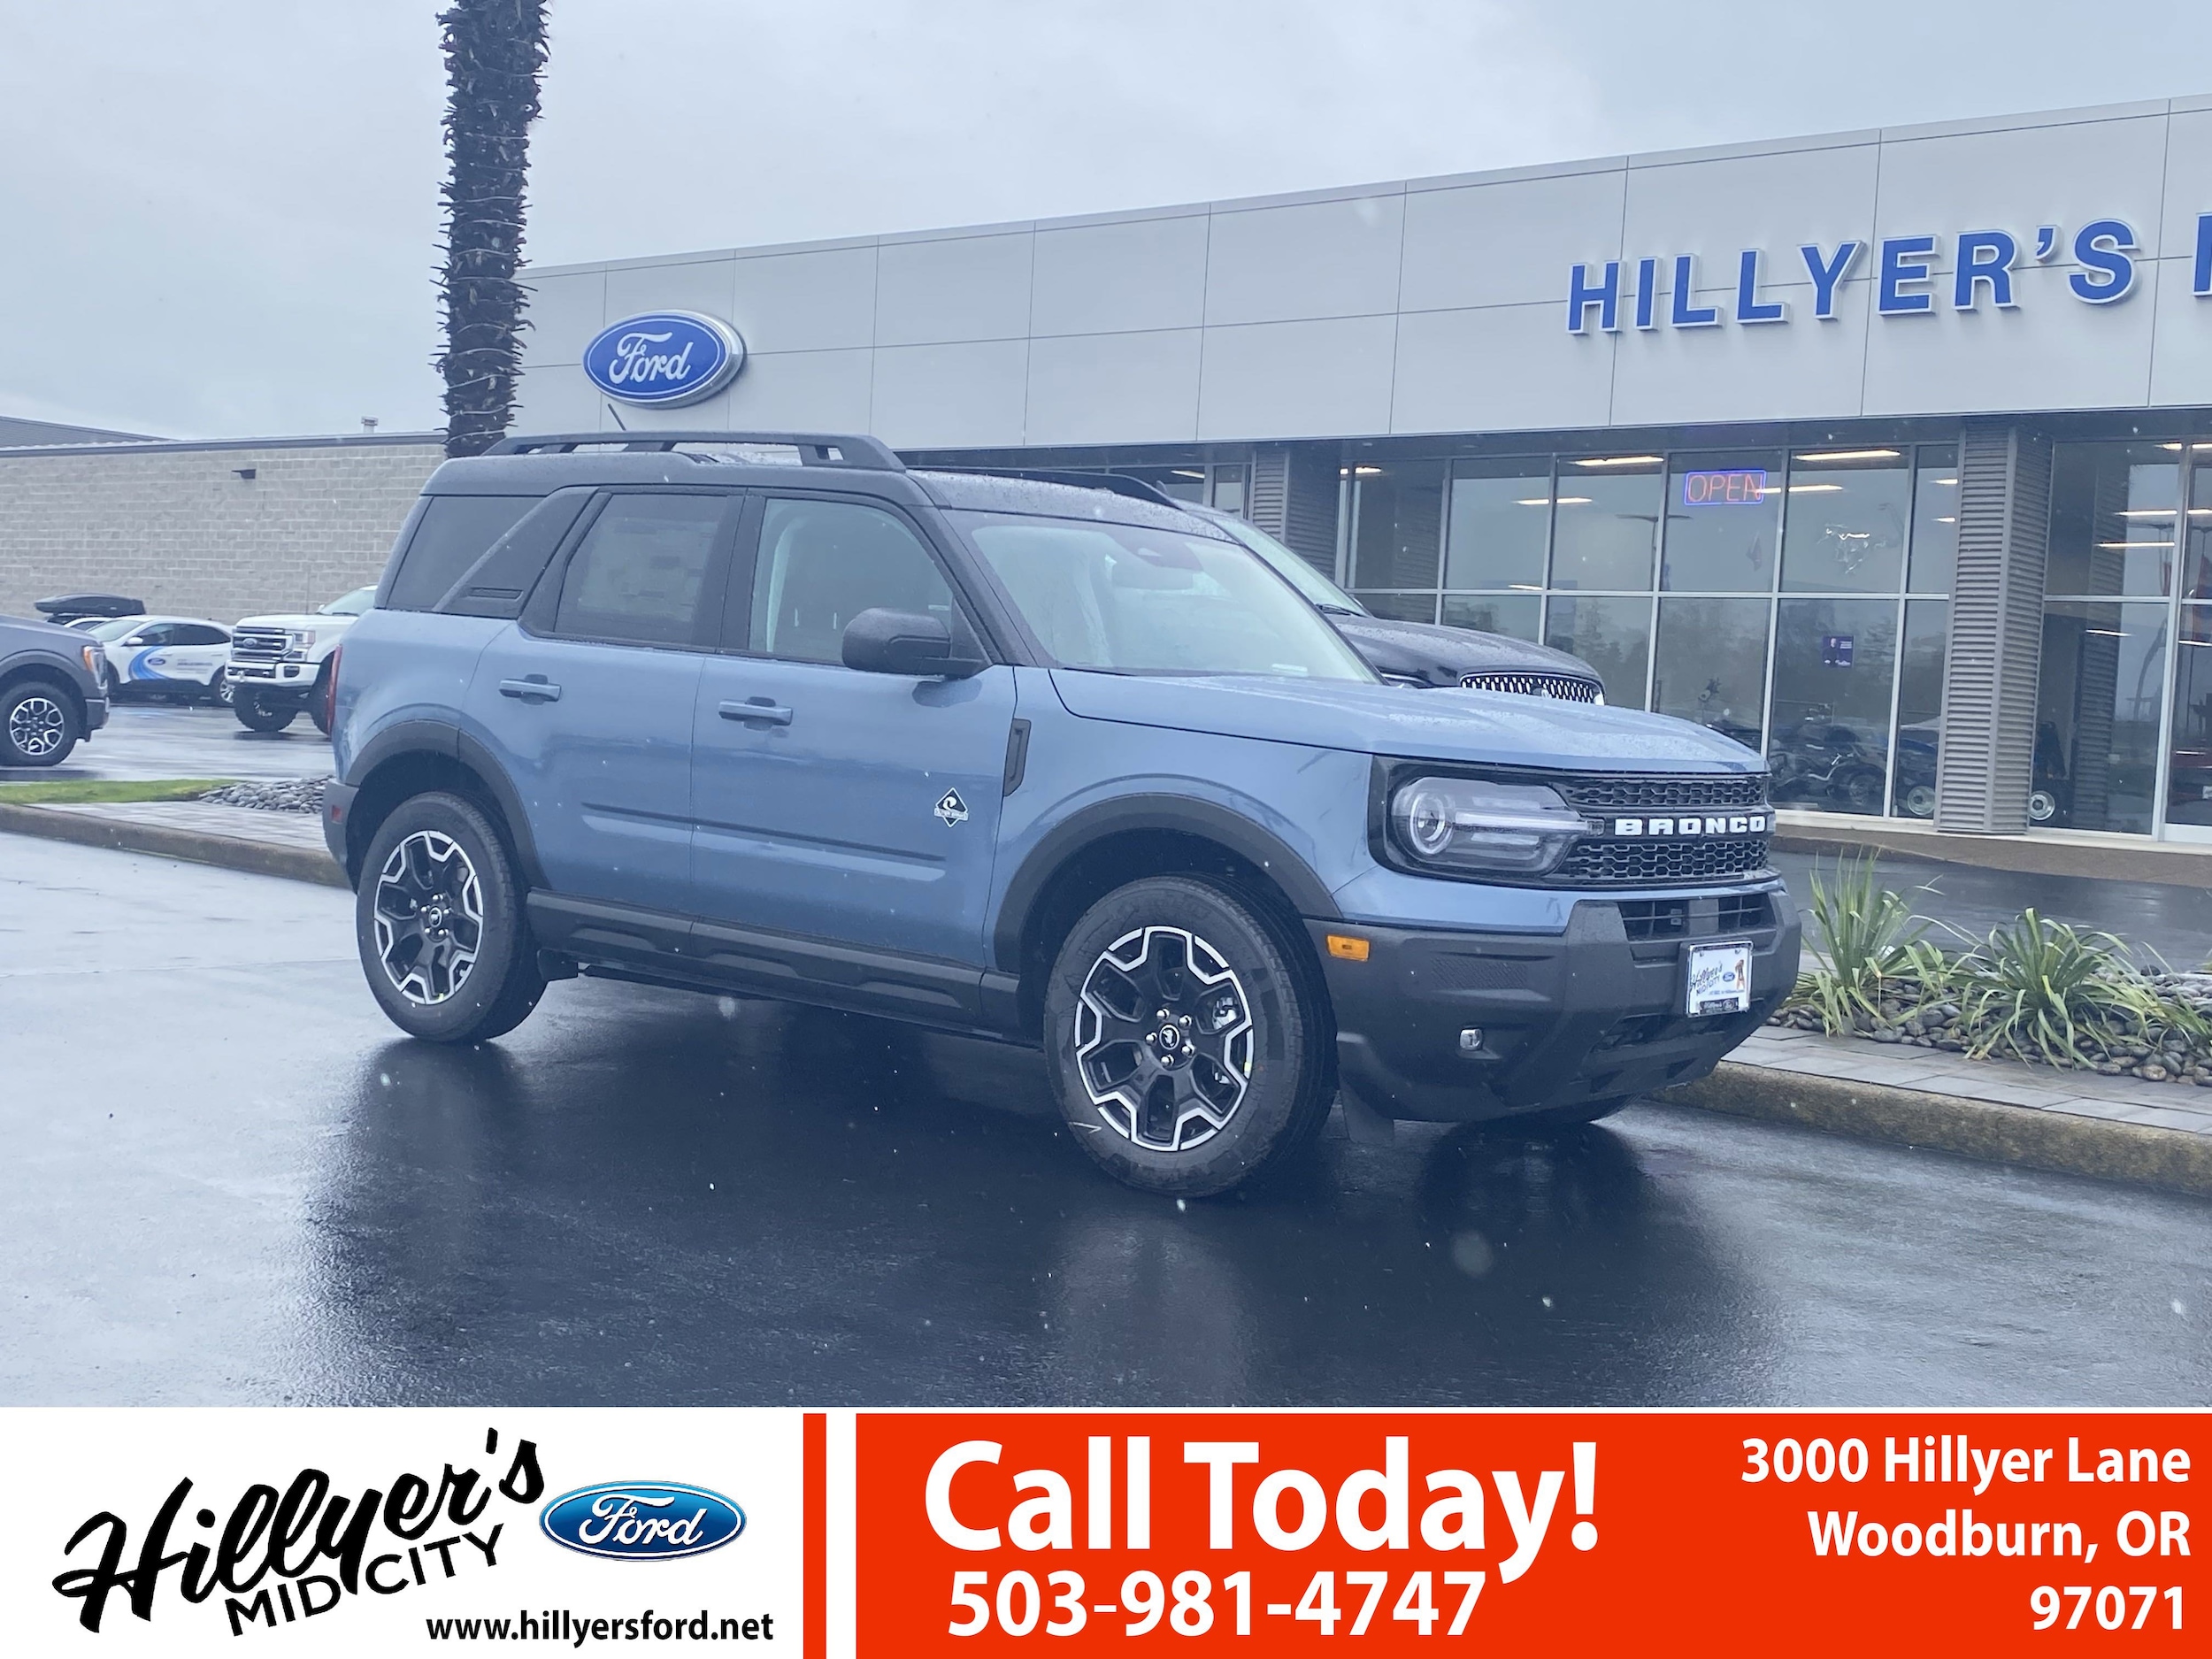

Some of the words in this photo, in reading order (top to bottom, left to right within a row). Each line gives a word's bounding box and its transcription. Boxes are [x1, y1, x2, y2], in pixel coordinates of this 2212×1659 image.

[1567, 219, 2139, 334] HILLYER'S
[609, 332, 694, 384] Ford
[1687, 473, 1763, 503] OPEN
[1615, 816, 1766, 836] BRONCO
